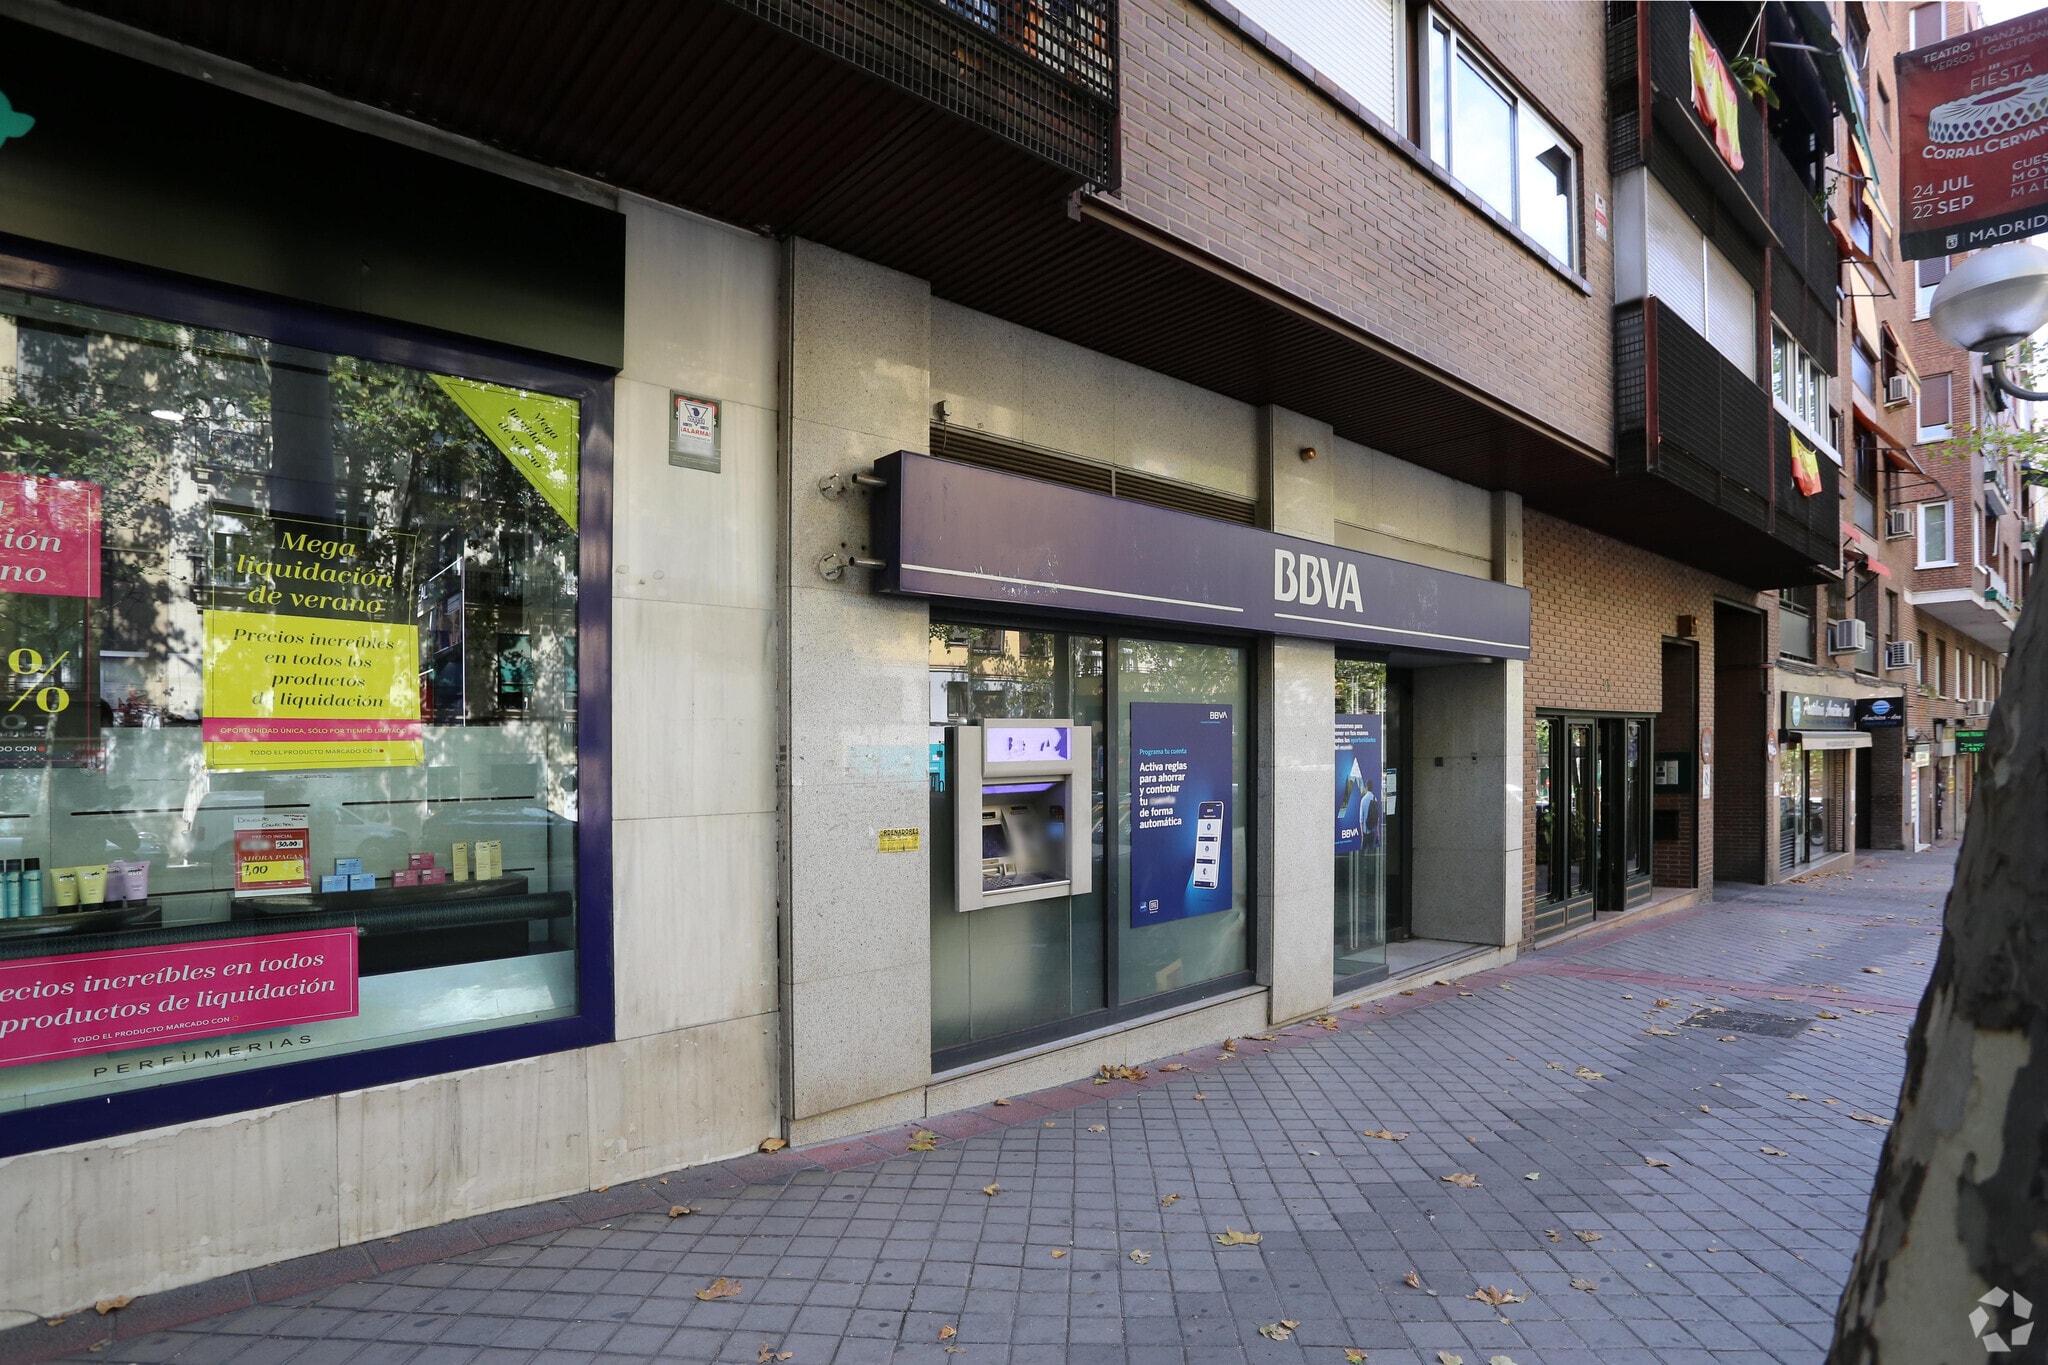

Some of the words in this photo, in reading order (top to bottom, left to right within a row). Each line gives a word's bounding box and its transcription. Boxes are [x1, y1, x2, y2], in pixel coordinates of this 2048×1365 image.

[1922, 42, 1971, 64] TEATRO
[1982, 26, 2024, 46] DANZA
[1931, 52, 1976, 72] VERSOS
[1970, 62, 2034, 91] FIESTA
[1913, 183, 1935, 199] 24
[1938, 175, 1975, 195] JUL
[1913, 203, 1933, 219] 22
[1937, 195, 1974, 214] SEP
[1969, 215, 2048, 243] MADRID
[0, 527, 63, 553] ión
[280, 531, 356, 560] Mega
[236, 554, 394, 588] liquidación
[1274, 548, 1364, 613] BBVA
[248, 585, 282, 605] de
[289, 592, 382, 615] verano
[233, 628, 305, 645] Precios
[309, 633, 395, 650] increíbles
[264, 653, 287, 665] en
[292, 653, 343, 667] todos
[348, 655, 372, 668] los
[8, 648, 70, 713] %
[271, 673, 366, 688] productos
[280, 692, 385, 709] liquidación
[1209, 711, 1228, 720] BBVA
[15, 745, 37, 753] CON
[1139, 748, 1164, 757] Programa
[1139, 762, 1164, 772] Activa
[1165, 761, 1188, 773] reglas
[1139, 774, 1157, 786] para
[1158, 772, 1186, 782] ahorrar
[1139, 787, 1145, 797] y
[1145, 784, 1180, 794] controlar
[1139, 797, 1148, 806] tu
[1139, 808, 1150, 818] de
[1150, 807, 1174, 817] forma
[1139, 817, 1182, 829] automática
[1341, 828, 1360, 839] BBVA
[83, 965, 216, 993] increíbles
[222, 961, 253, 977] en
[259, 953, 325, 973] todos
[0, 1002, 151, 1039] productos
[157, 994, 190, 1013] de
[196, 977, 336, 1009] liquidación
[72, 1034, 100, 1044] TODO
[102, 1032, 113, 1040] EL
[114, 1025, 164, 1038] PRODUCTO
[166, 1019, 210, 1031] MARCADO
[211, 1016, 230, 1024] CON
